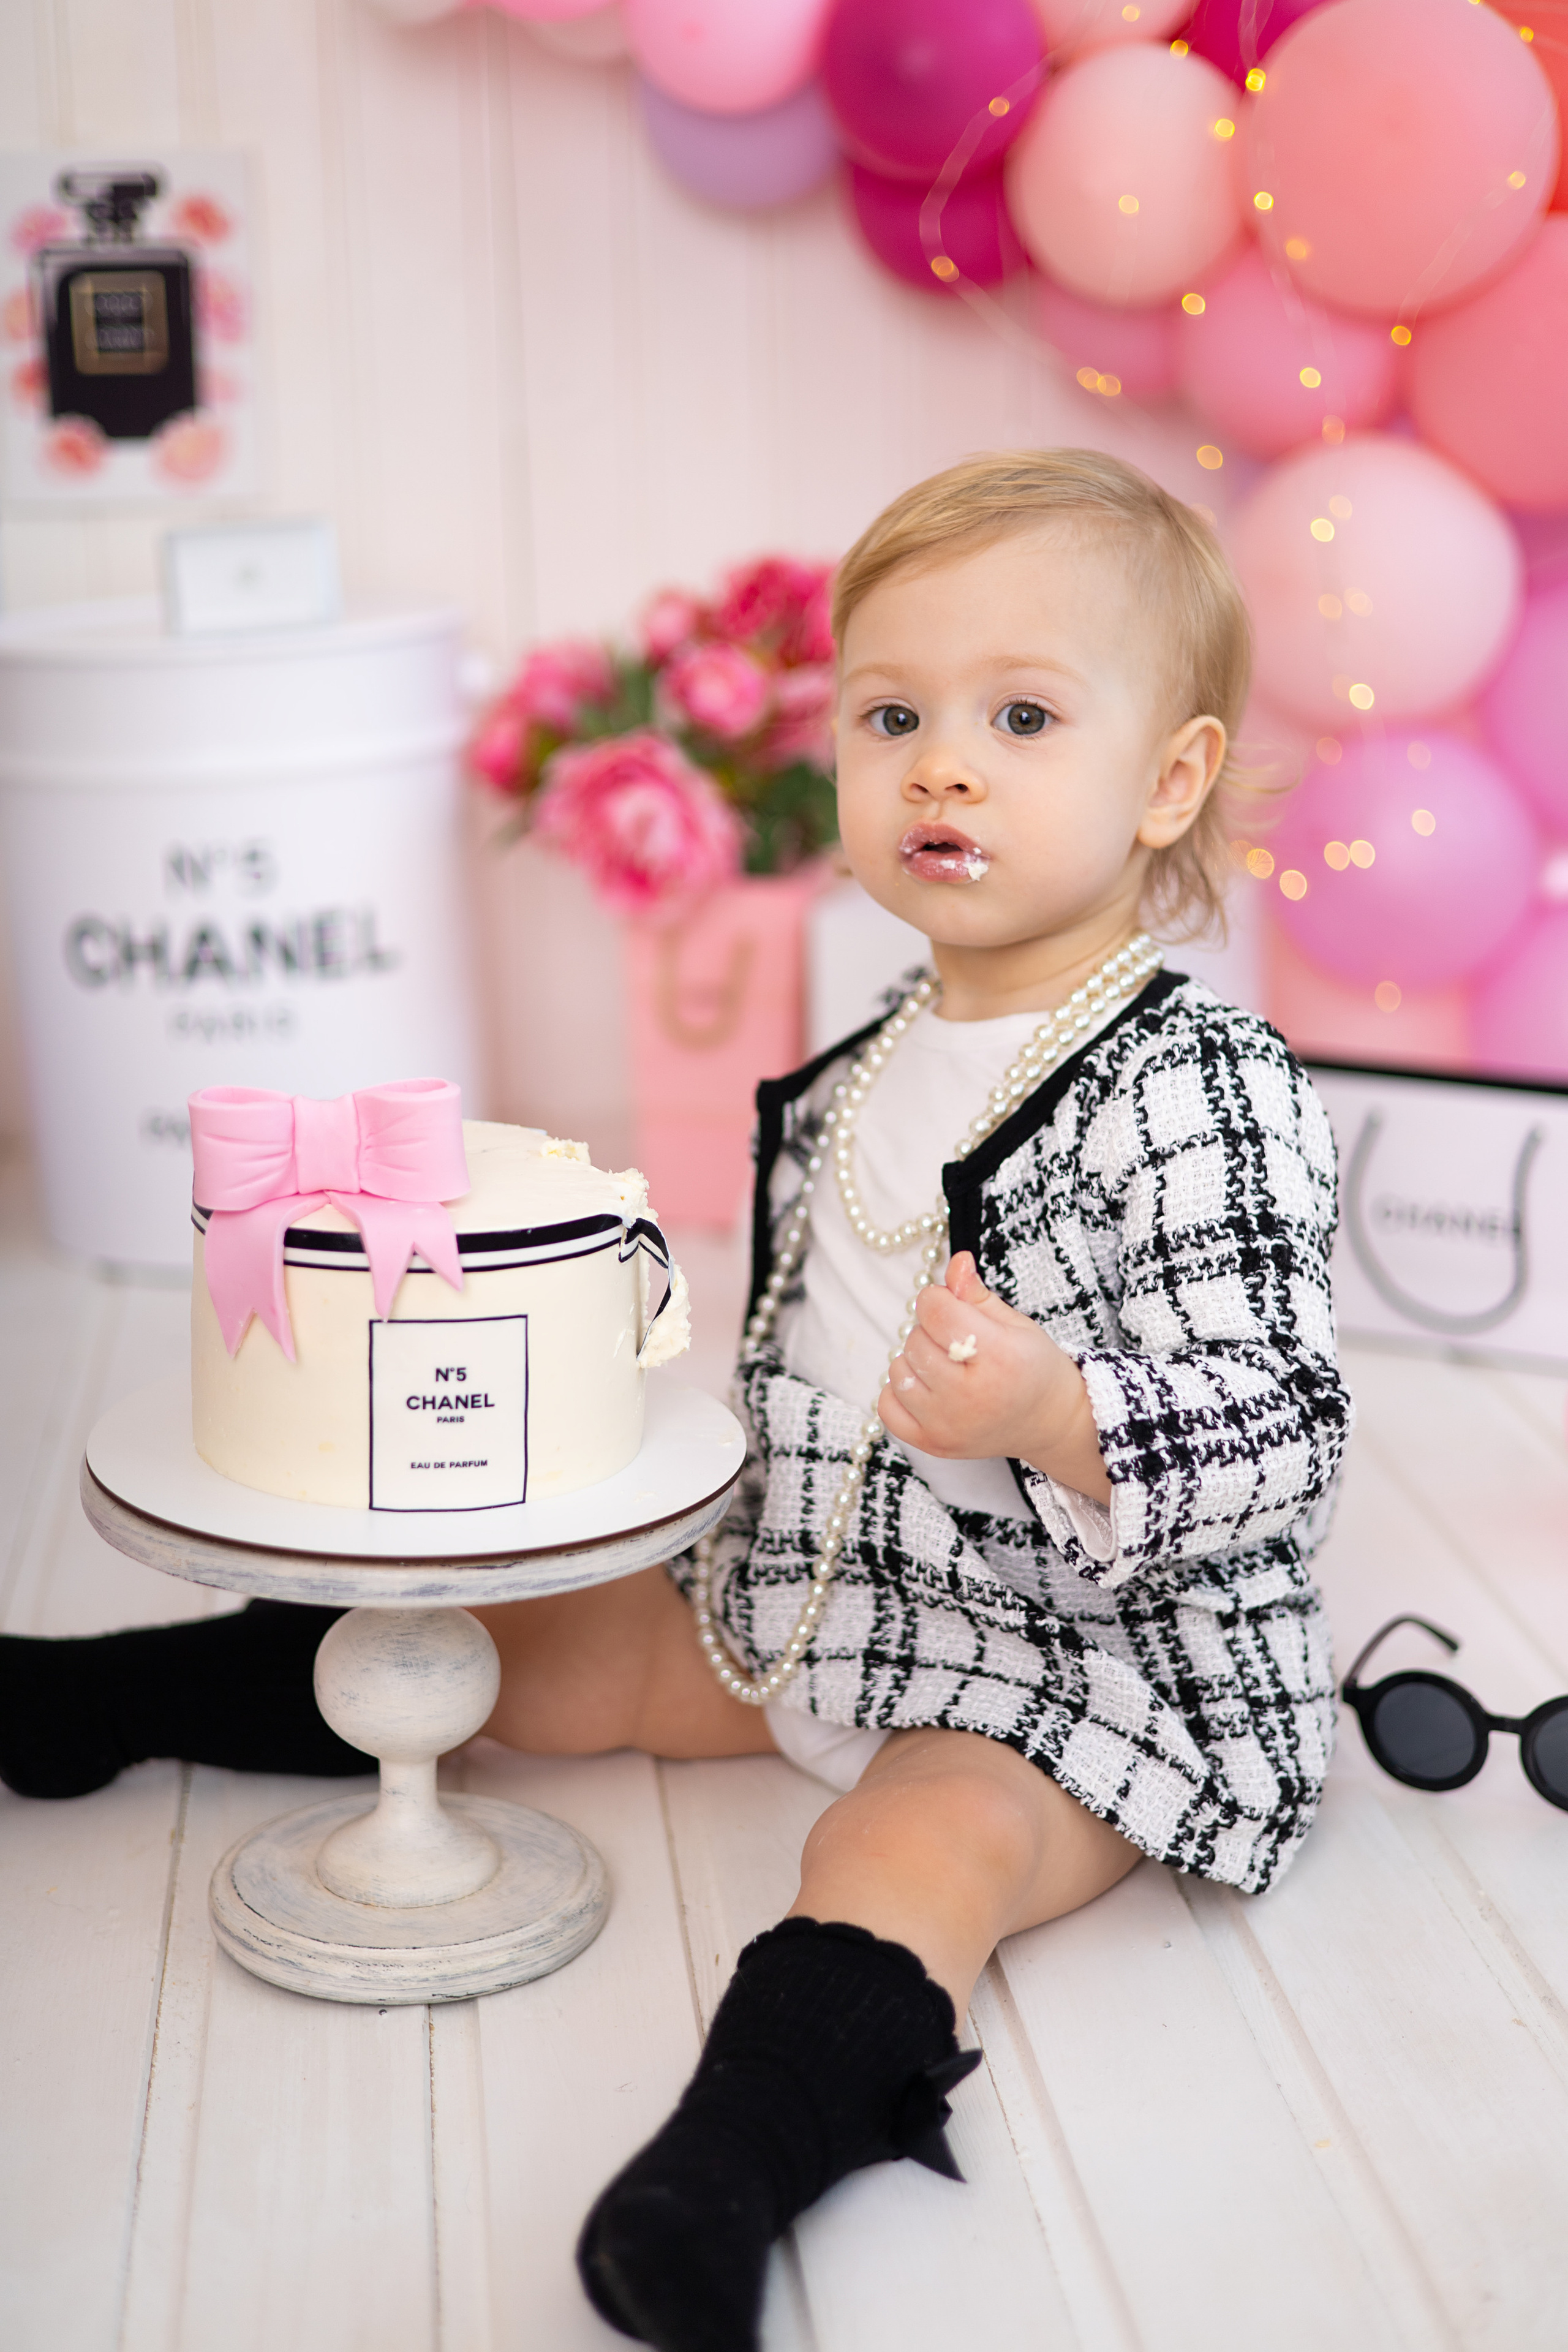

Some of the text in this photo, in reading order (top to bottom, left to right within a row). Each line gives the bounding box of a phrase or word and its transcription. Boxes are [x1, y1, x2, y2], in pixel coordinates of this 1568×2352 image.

[65, 905, 398, 990] CHANEL
[435, 1366, 467, 1382] N°5
[405, 1393, 496, 1411] CHANEL
[436, 1415, 466, 1423] PARIS
[449, 1459, 488, 1469] PARFUM
